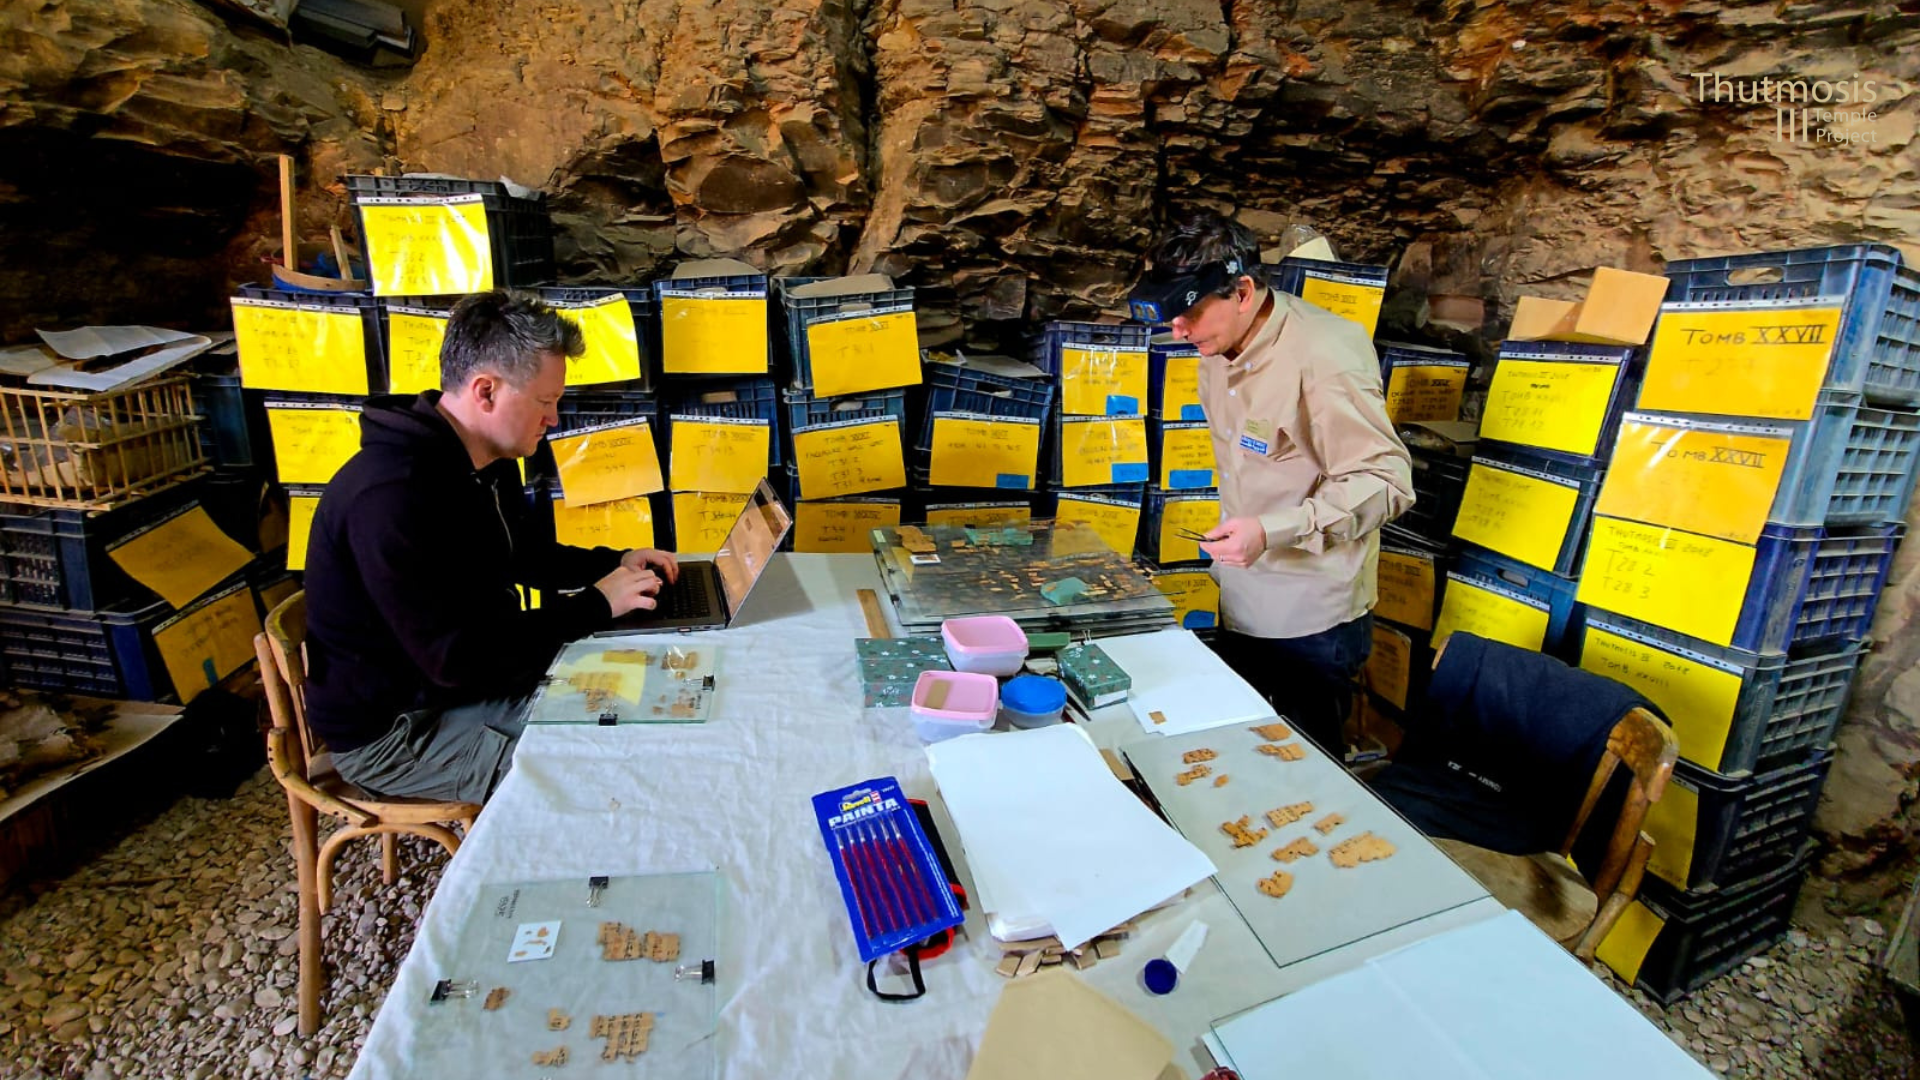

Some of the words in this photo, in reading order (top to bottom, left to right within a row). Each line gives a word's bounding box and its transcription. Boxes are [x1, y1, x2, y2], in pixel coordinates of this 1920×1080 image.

[1680, 328, 1746, 346] TOMB
[1748, 324, 1828, 345] XXVII
[1708, 446, 1767, 468] XXVII
[828, 797, 899, 827] PAINTA
